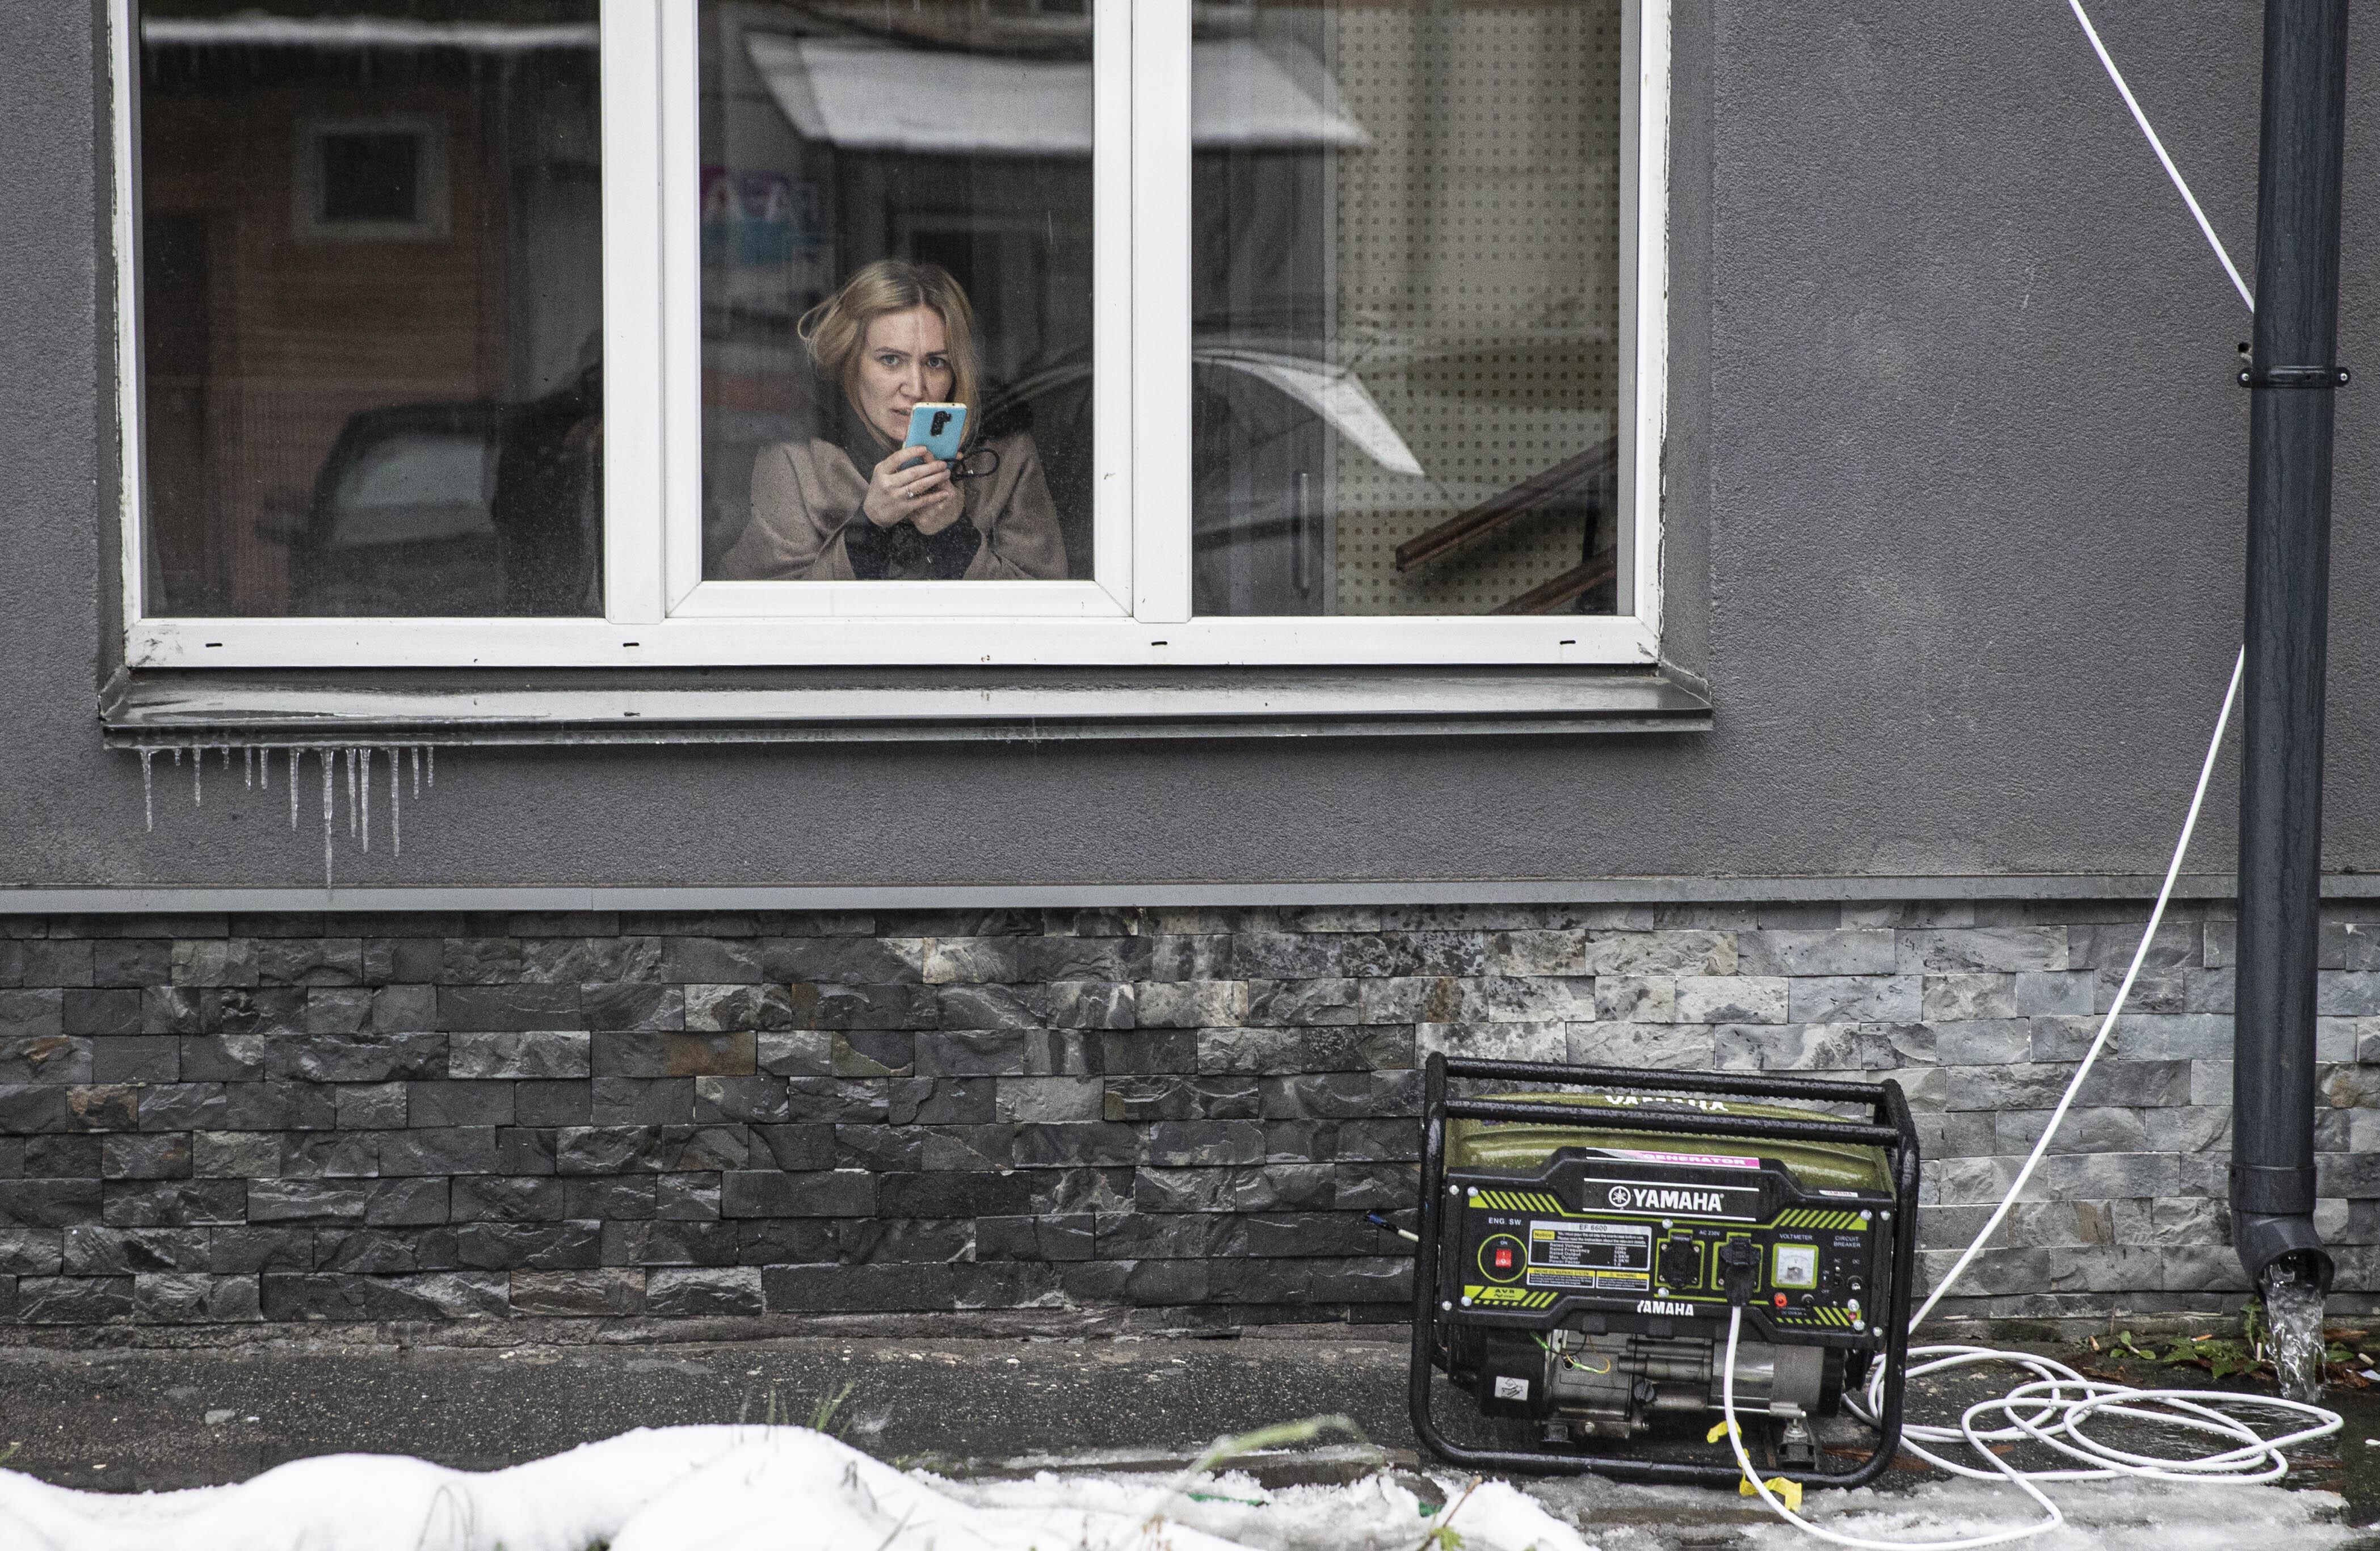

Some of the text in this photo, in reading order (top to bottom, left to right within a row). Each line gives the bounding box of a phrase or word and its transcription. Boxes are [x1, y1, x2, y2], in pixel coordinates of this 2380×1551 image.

[1642, 1154, 1746, 1165] GENERATOR
[1633, 1189, 1722, 1212] YAMAHA
[1637, 1300, 1694, 1316] YAMAHA
